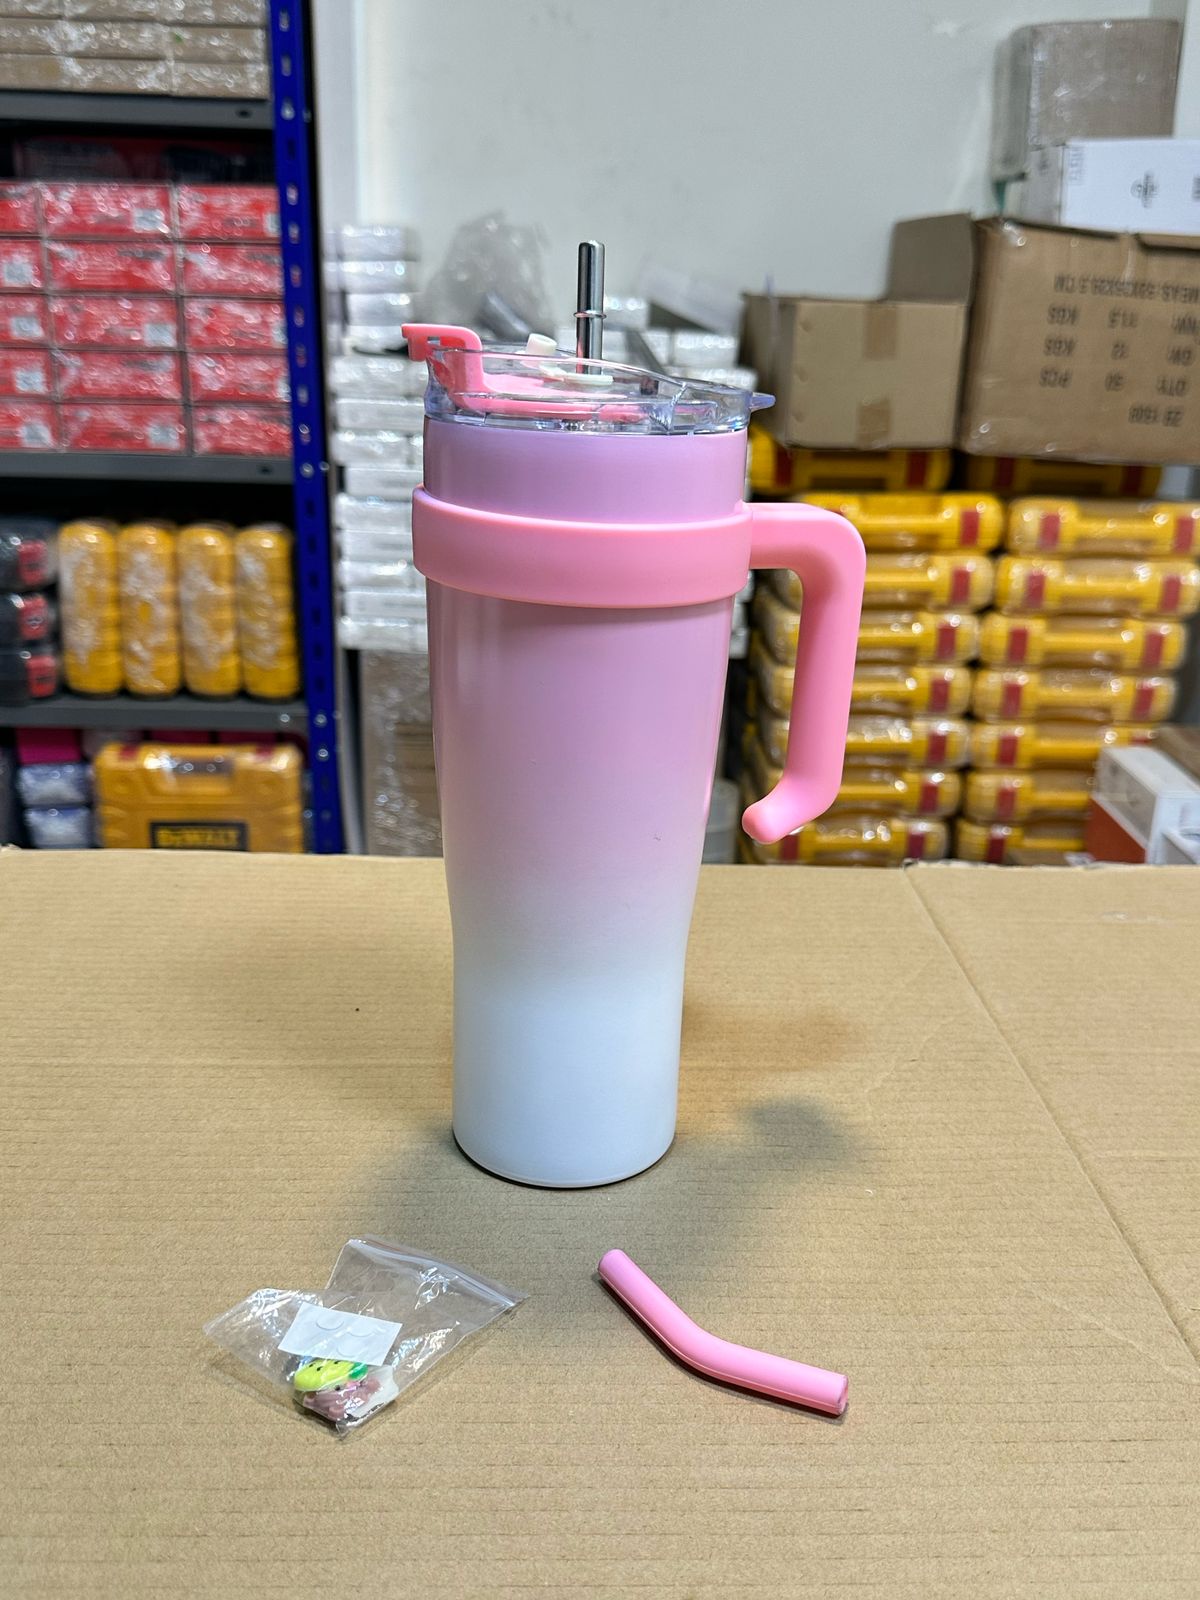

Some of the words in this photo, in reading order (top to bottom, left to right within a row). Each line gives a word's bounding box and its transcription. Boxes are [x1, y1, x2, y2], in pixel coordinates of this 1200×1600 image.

[1048, 305, 1078, 325] KGS
[1043, 337, 1076, 357] KGS
[1038, 367, 1073, 388] PCS
